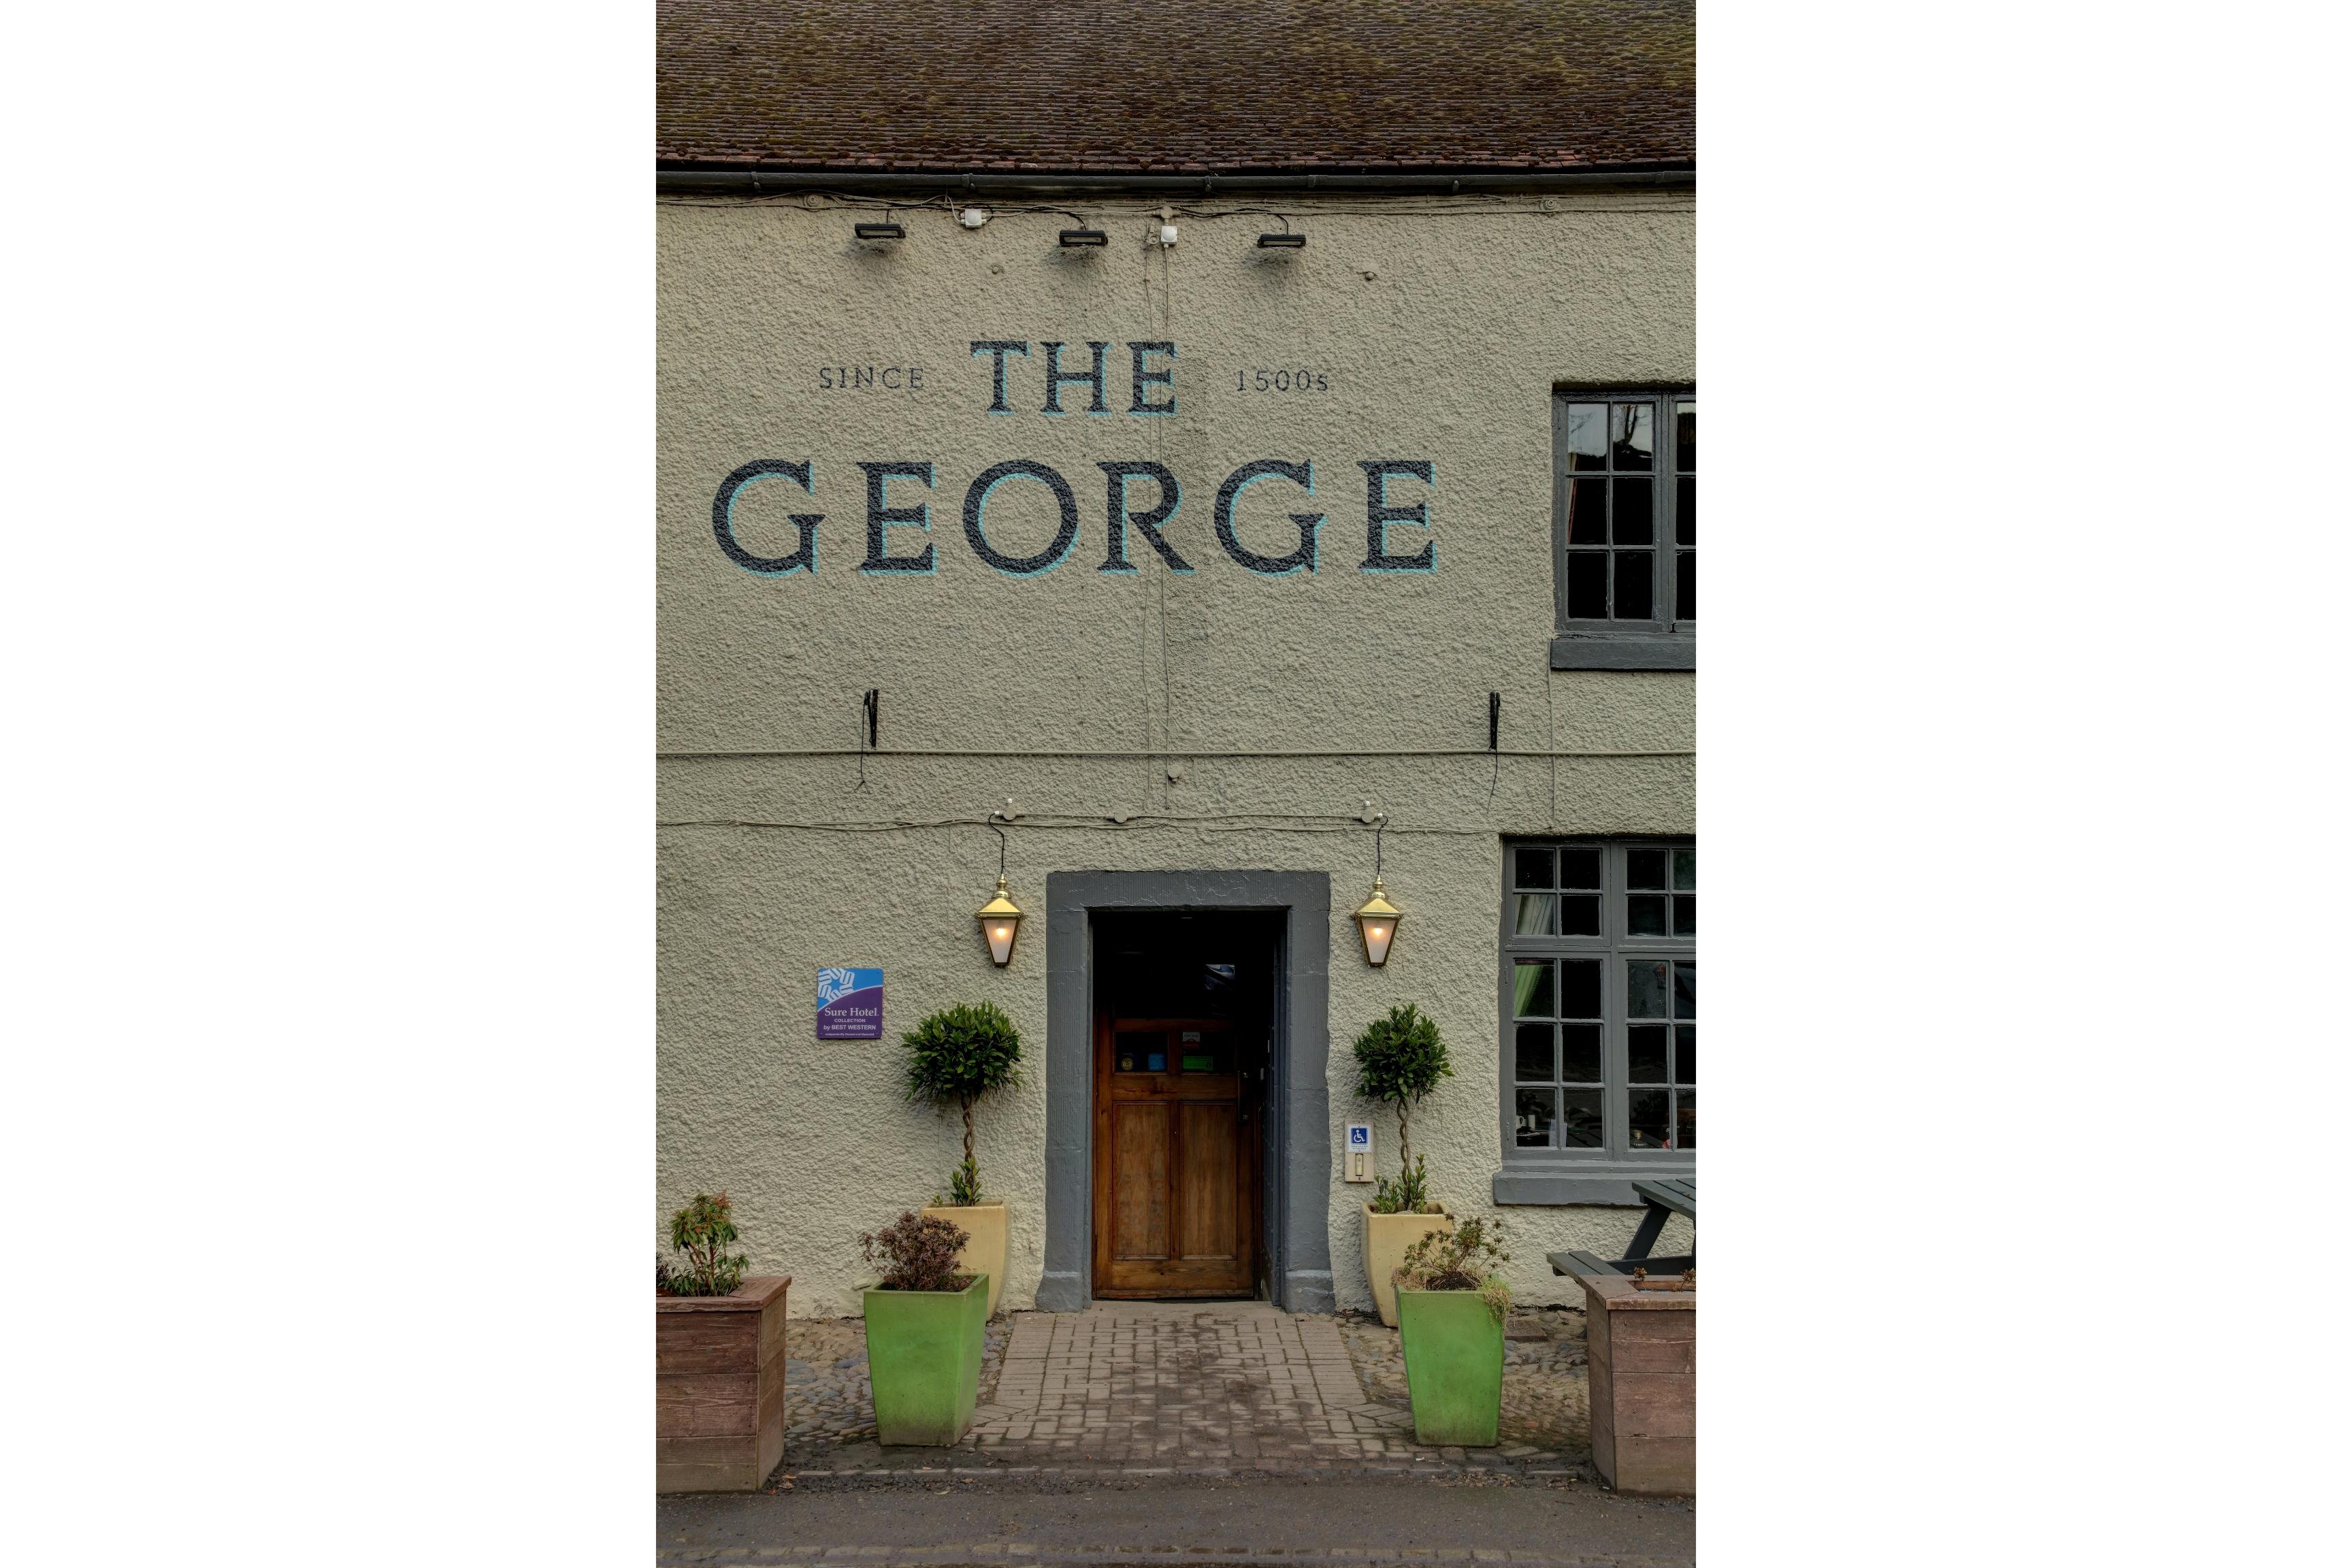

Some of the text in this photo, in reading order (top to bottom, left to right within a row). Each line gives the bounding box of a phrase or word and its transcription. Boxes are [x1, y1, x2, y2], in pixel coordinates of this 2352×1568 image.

[819, 366, 926, 390] SINCE
[969, 340, 1178, 416] THE
[1235, 368, 1330, 393] 1500s
[711, 459, 1439, 577] GEORGE
[824, 1007, 878, 1017] Sure Hotel
